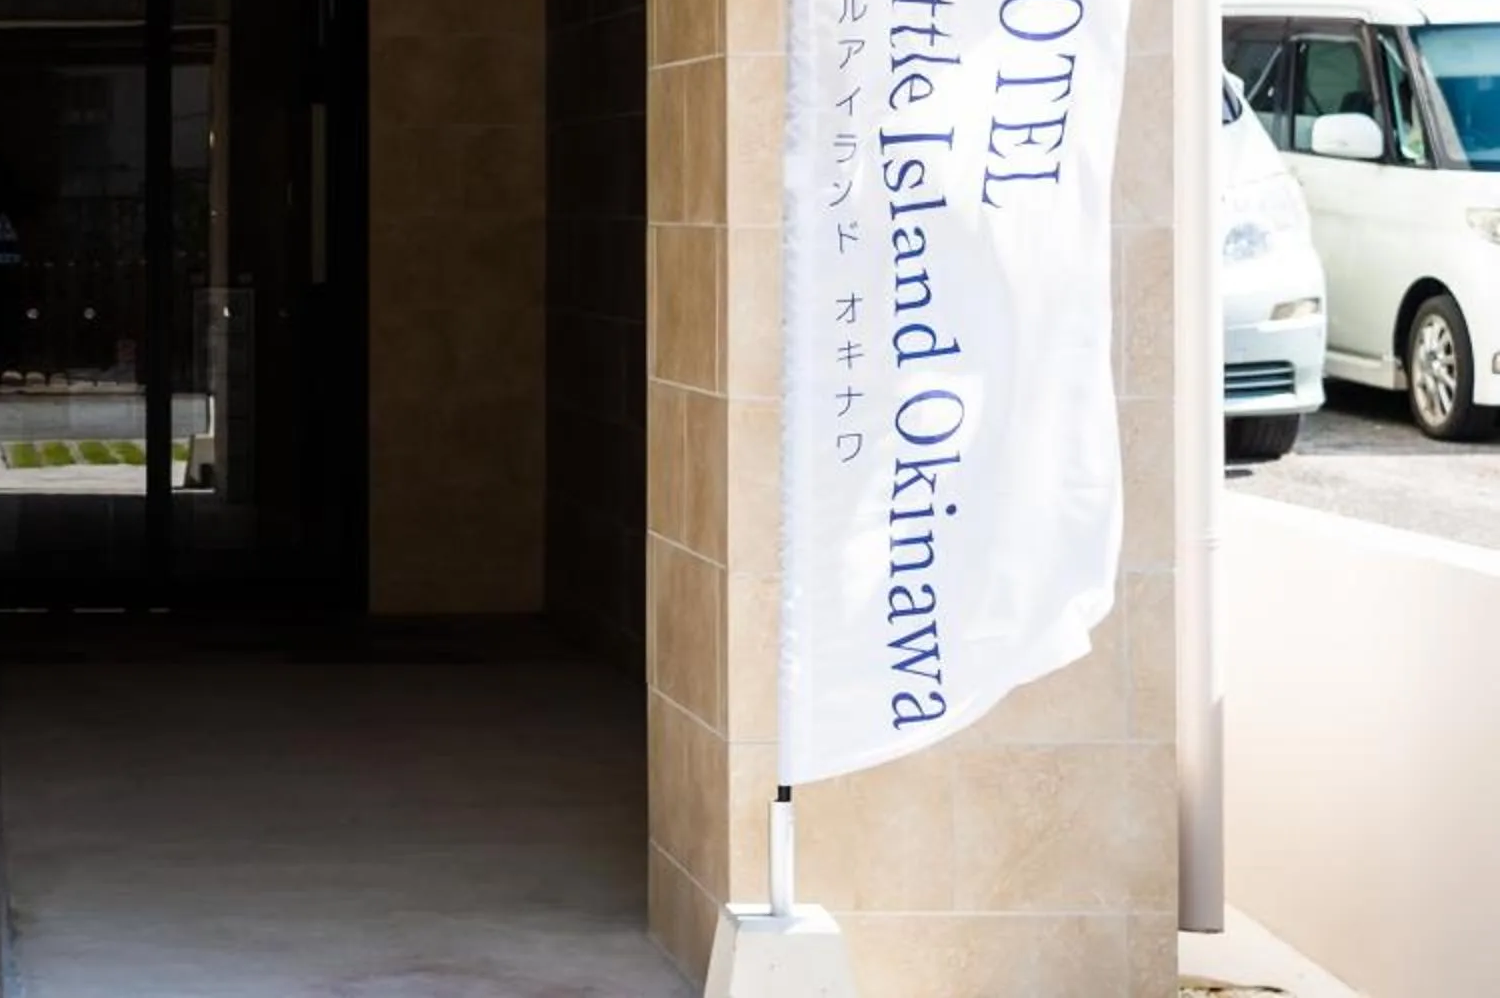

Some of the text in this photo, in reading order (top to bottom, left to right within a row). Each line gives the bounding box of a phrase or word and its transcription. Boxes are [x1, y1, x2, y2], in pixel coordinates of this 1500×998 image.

[878, 126, 961, 368] Island
[835, 292, 864, 463] オキナワ
[886, 389, 966, 730] Okinawa
